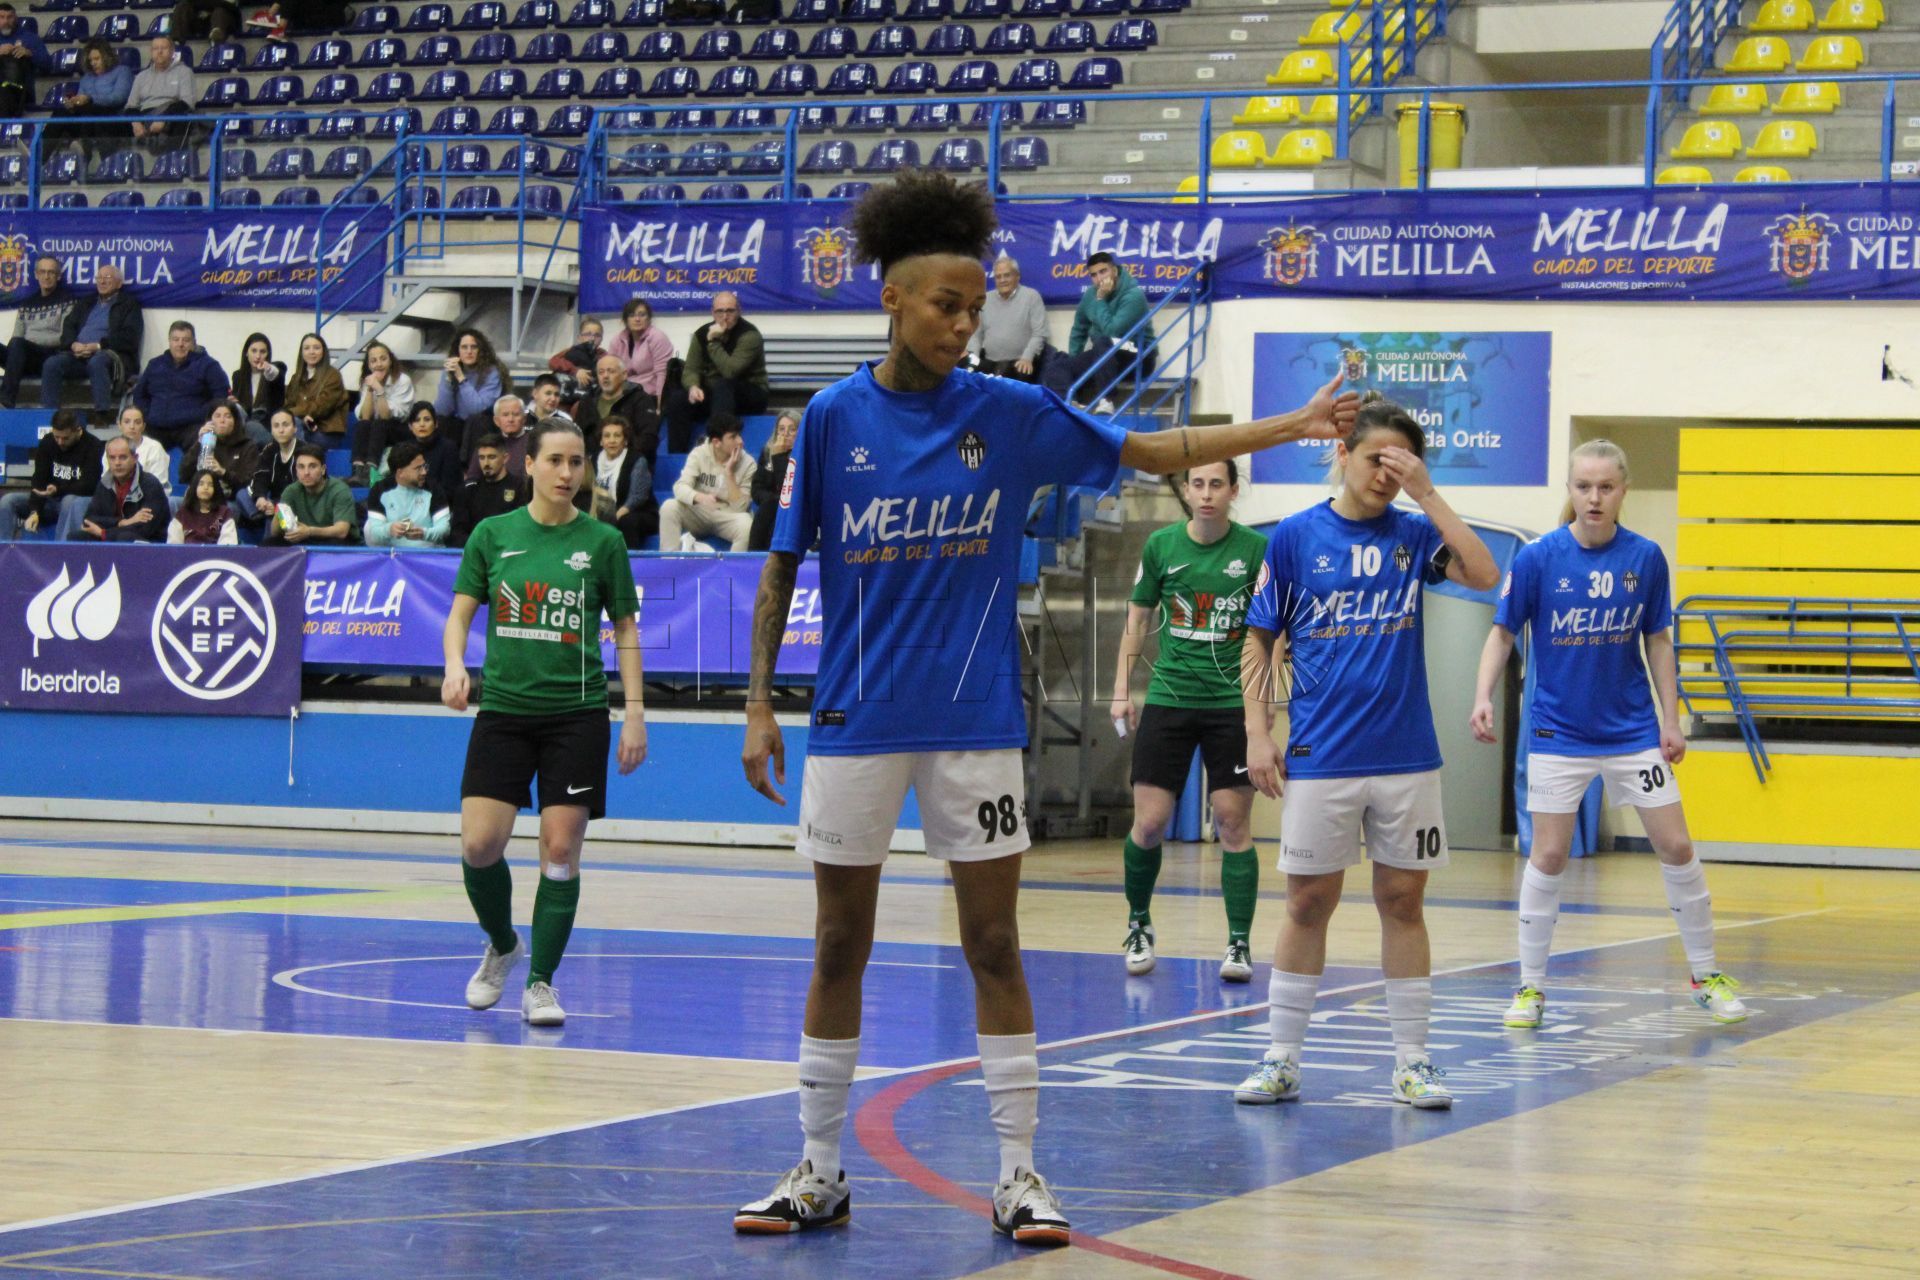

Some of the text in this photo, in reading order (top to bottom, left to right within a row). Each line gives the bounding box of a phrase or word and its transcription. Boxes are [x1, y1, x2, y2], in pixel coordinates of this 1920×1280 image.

[1333, 221, 1496, 240] CIUDAD AUTÓNOMA
[1532, 202, 1729, 256] MELILLA
[1847, 217, 1913, 232] CIUDAD
[42, 236, 174, 252] CIUDAD AUTÓNOMA
[201, 219, 359, 268] MELILLA
[605, 218, 767, 265] MELILLA
[1050, 213, 1224, 262] MELILLA
[1336, 243, 1497, 277] MELILLA
[1533, 256, 1717, 275] CIUDAD DEL DEPORTE
[201, 269, 252, 285] CIUDAD
[606, 267, 758, 285] CIUDAD DEL DEPORTE
[1561, 281, 1629, 290] INSTALACIONES
[1375, 352, 1410, 361] CIUDAD
[1377, 363, 1468, 382] MELILLA
[1453, 430, 1501, 449] Ortíz
[845, 463, 877, 472] KELME
[841, 488, 1000, 545] MELILLA
[844, 546, 899, 564] CIUDAD
[906, 544, 933, 560] DEL
[1351, 544, 1382, 578] 10
[1587, 570, 1614, 599] 30
[525, 581, 584, 609] West
[1195, 592, 1246, 611] West
[522, 603, 581, 630] Side
[1195, 612, 1242, 630] Side
[322, 622, 342, 635] DEL
[347, 621, 402, 637] DEPORTE
[21, 667, 120, 695] Iberdrola
[1639, 765, 1665, 793] 30
[977, 794, 1018, 844] 98
[1416, 826, 1440, 860] 10
